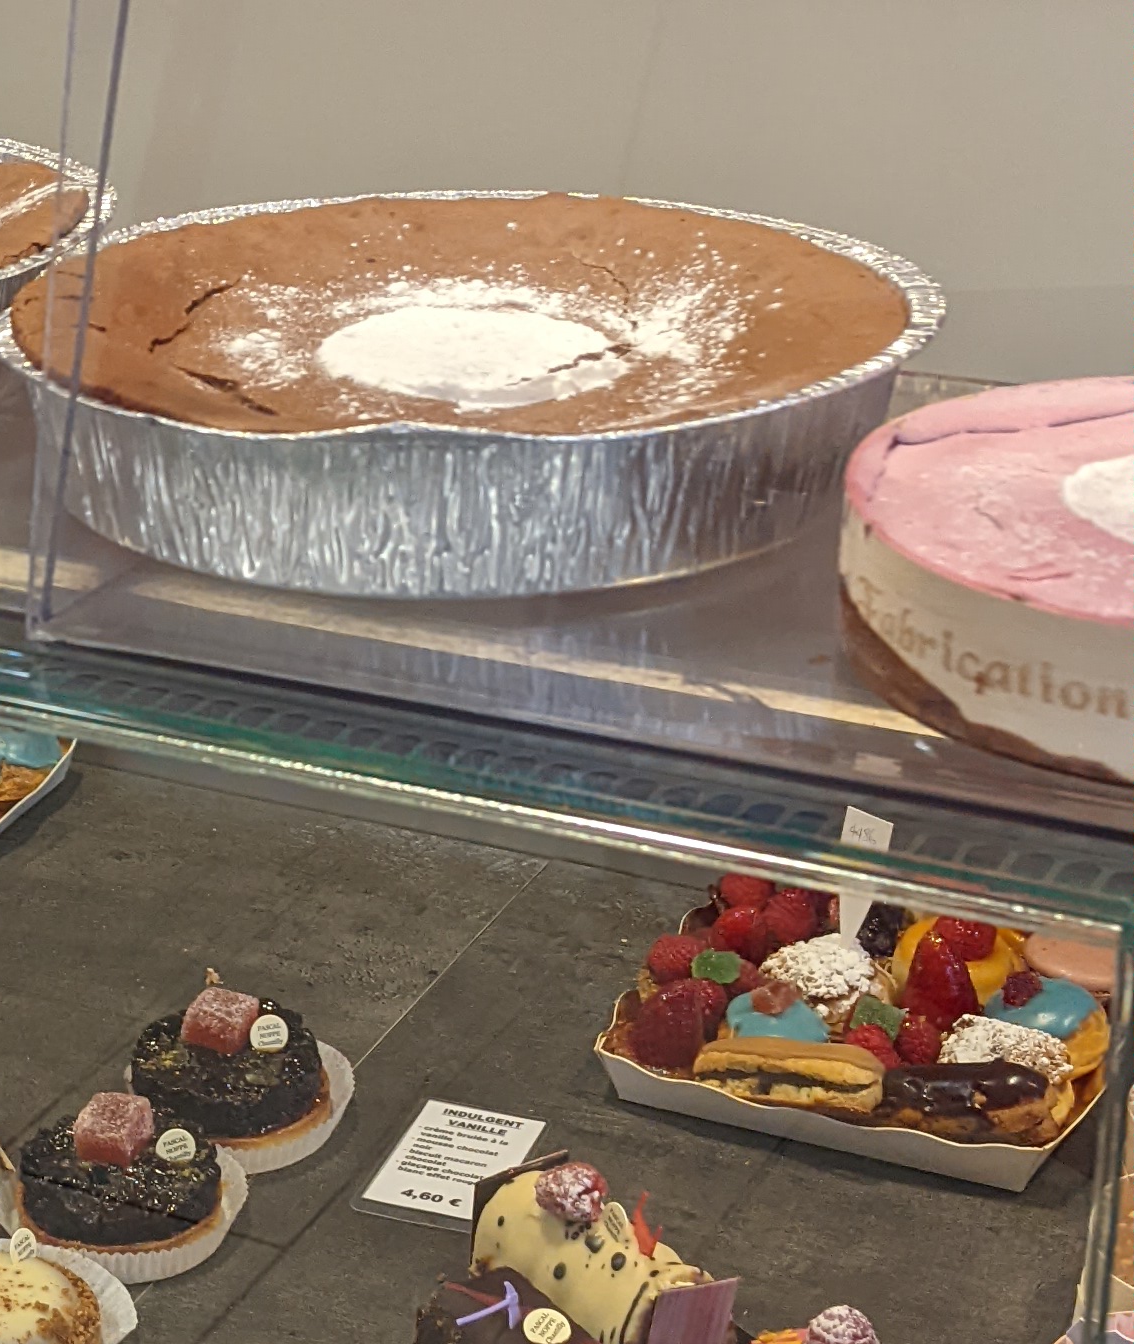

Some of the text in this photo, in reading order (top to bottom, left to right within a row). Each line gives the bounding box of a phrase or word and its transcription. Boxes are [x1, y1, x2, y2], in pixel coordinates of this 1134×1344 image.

[855, 575, 1129, 719] Fabrication
[530, 1312, 549, 1333] PASCAL
[539, 1317, 556, 1336] NOPPE
